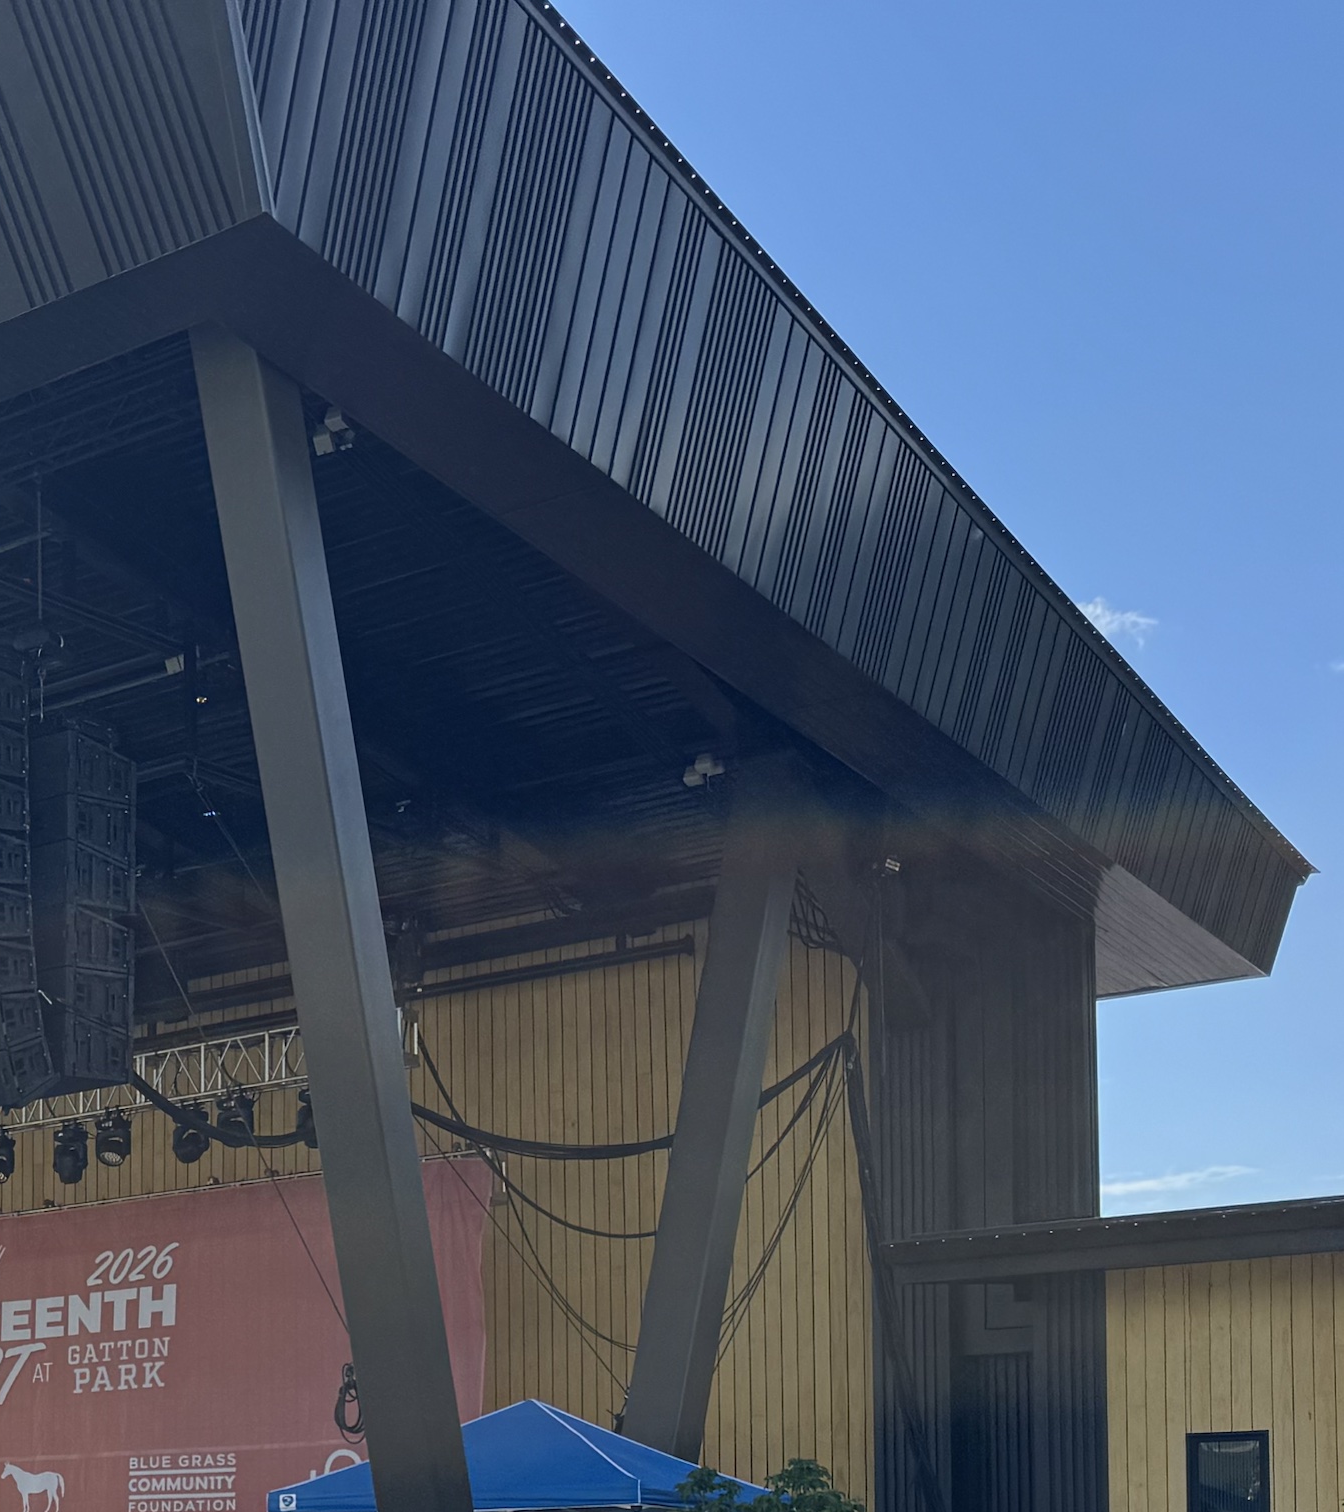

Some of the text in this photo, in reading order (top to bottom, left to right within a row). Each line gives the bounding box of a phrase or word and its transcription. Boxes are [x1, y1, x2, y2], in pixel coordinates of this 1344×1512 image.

[86, 1242, 180, 1286] 2026
[67, 1337, 171, 1365] GATTON
[32, 1362, 54, 1384] AT
[73, 1361, 165, 1394] PARK
[129, 1453, 237, 1470] BLUE GRASS
[128, 1475, 236, 1493] COMMUNITY
